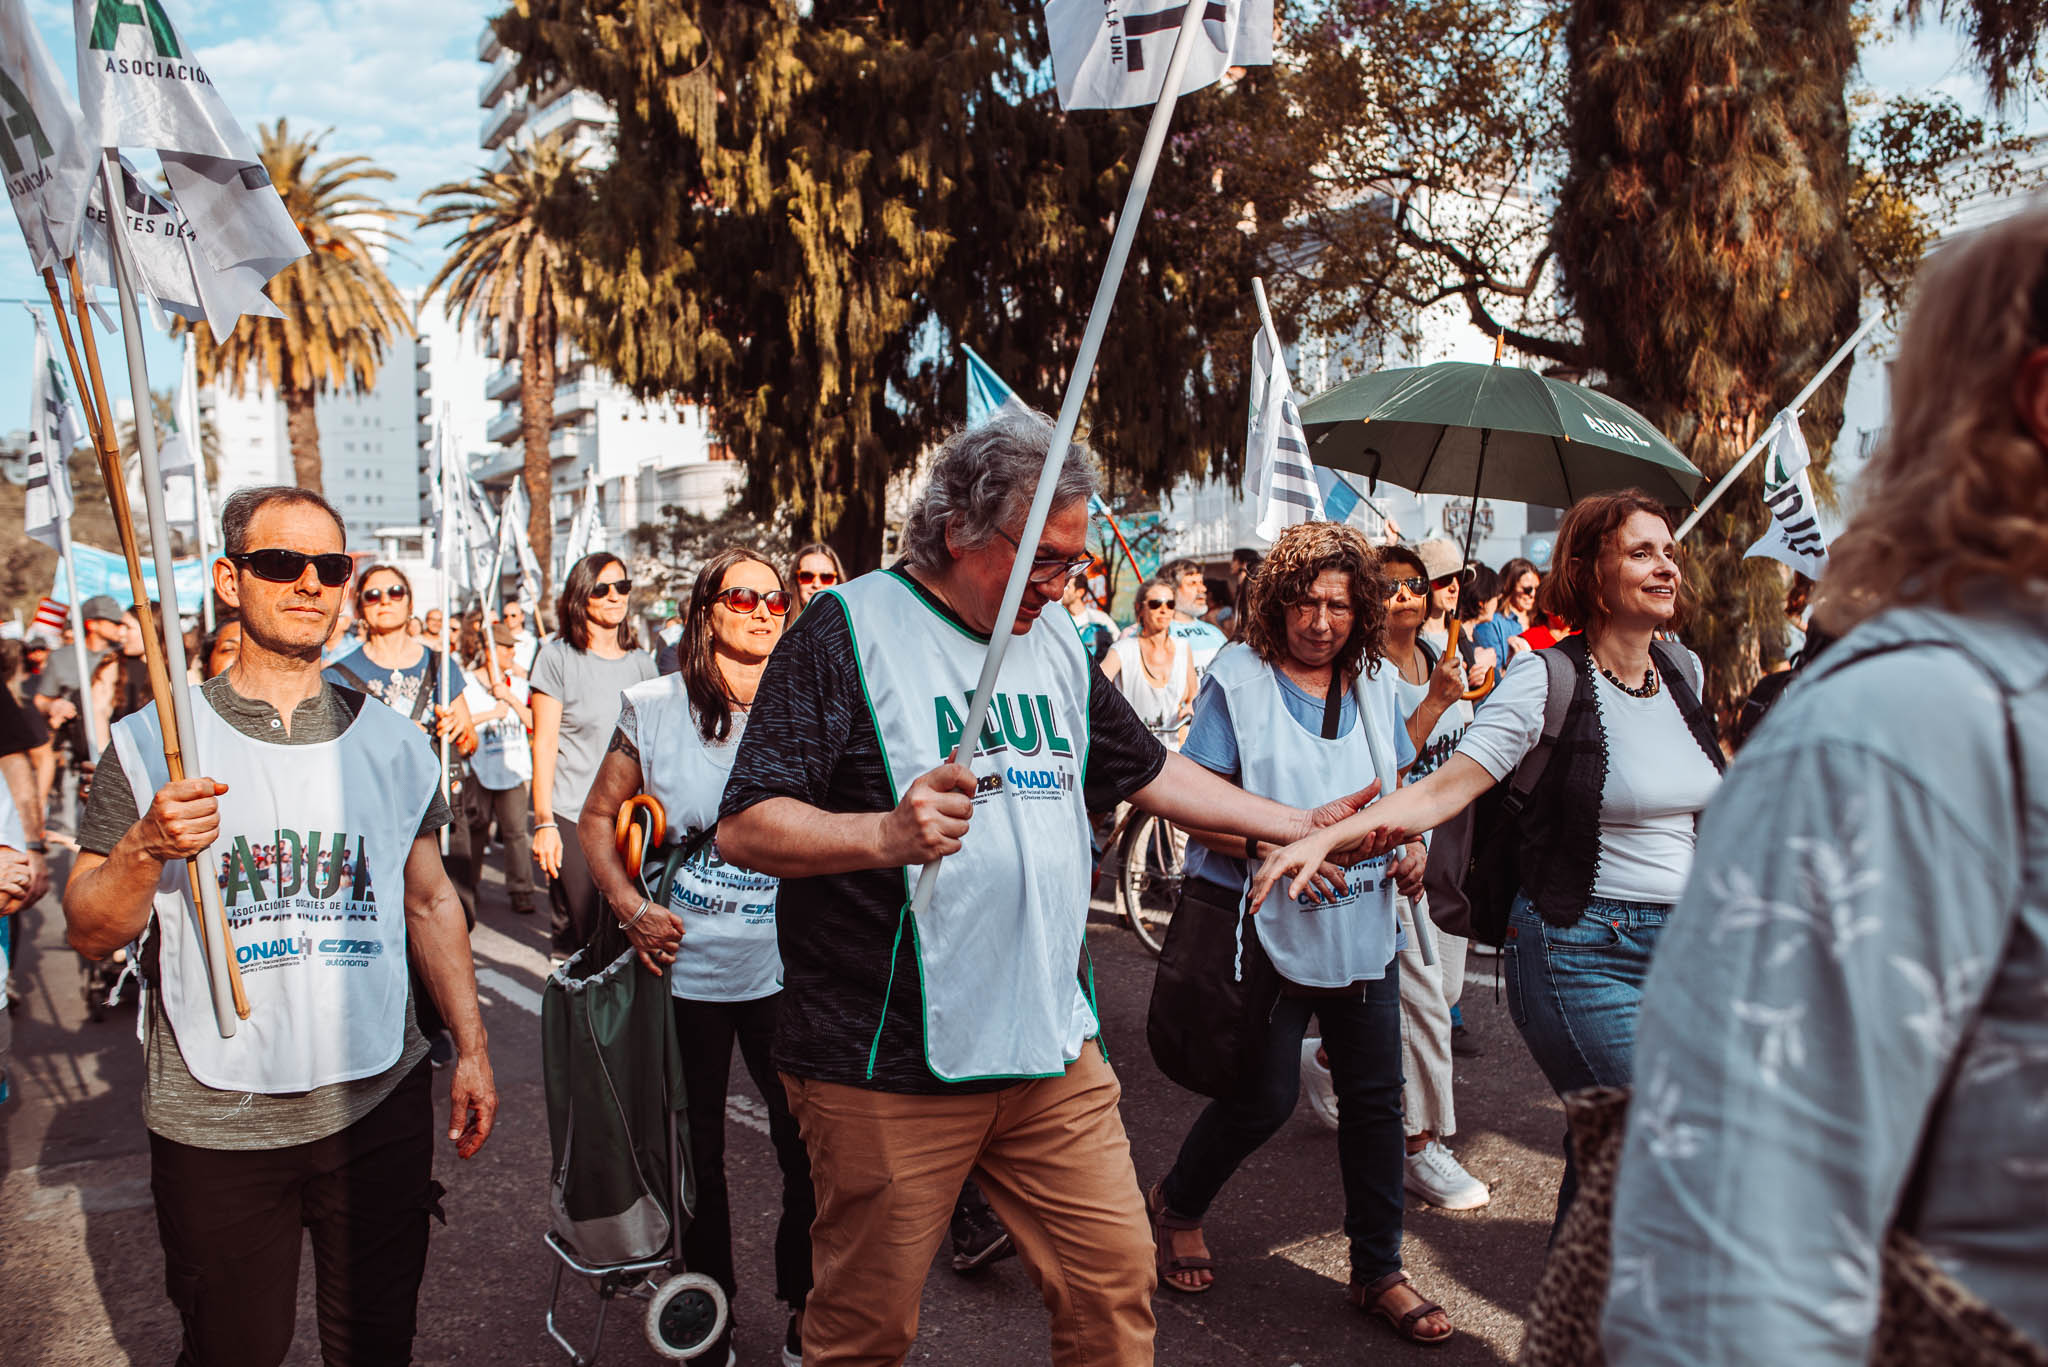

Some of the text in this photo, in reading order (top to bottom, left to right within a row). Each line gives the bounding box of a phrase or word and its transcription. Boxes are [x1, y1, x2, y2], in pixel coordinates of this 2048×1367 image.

[1110, 35, 1124, 65] UNL
[1582, 412, 1651, 448] ADUL
[330, 901, 342, 910] DE
[345, 902, 358, 911] LA
[362, 903, 378, 913] UNL
[325, 958, 370, 968] autónoma
